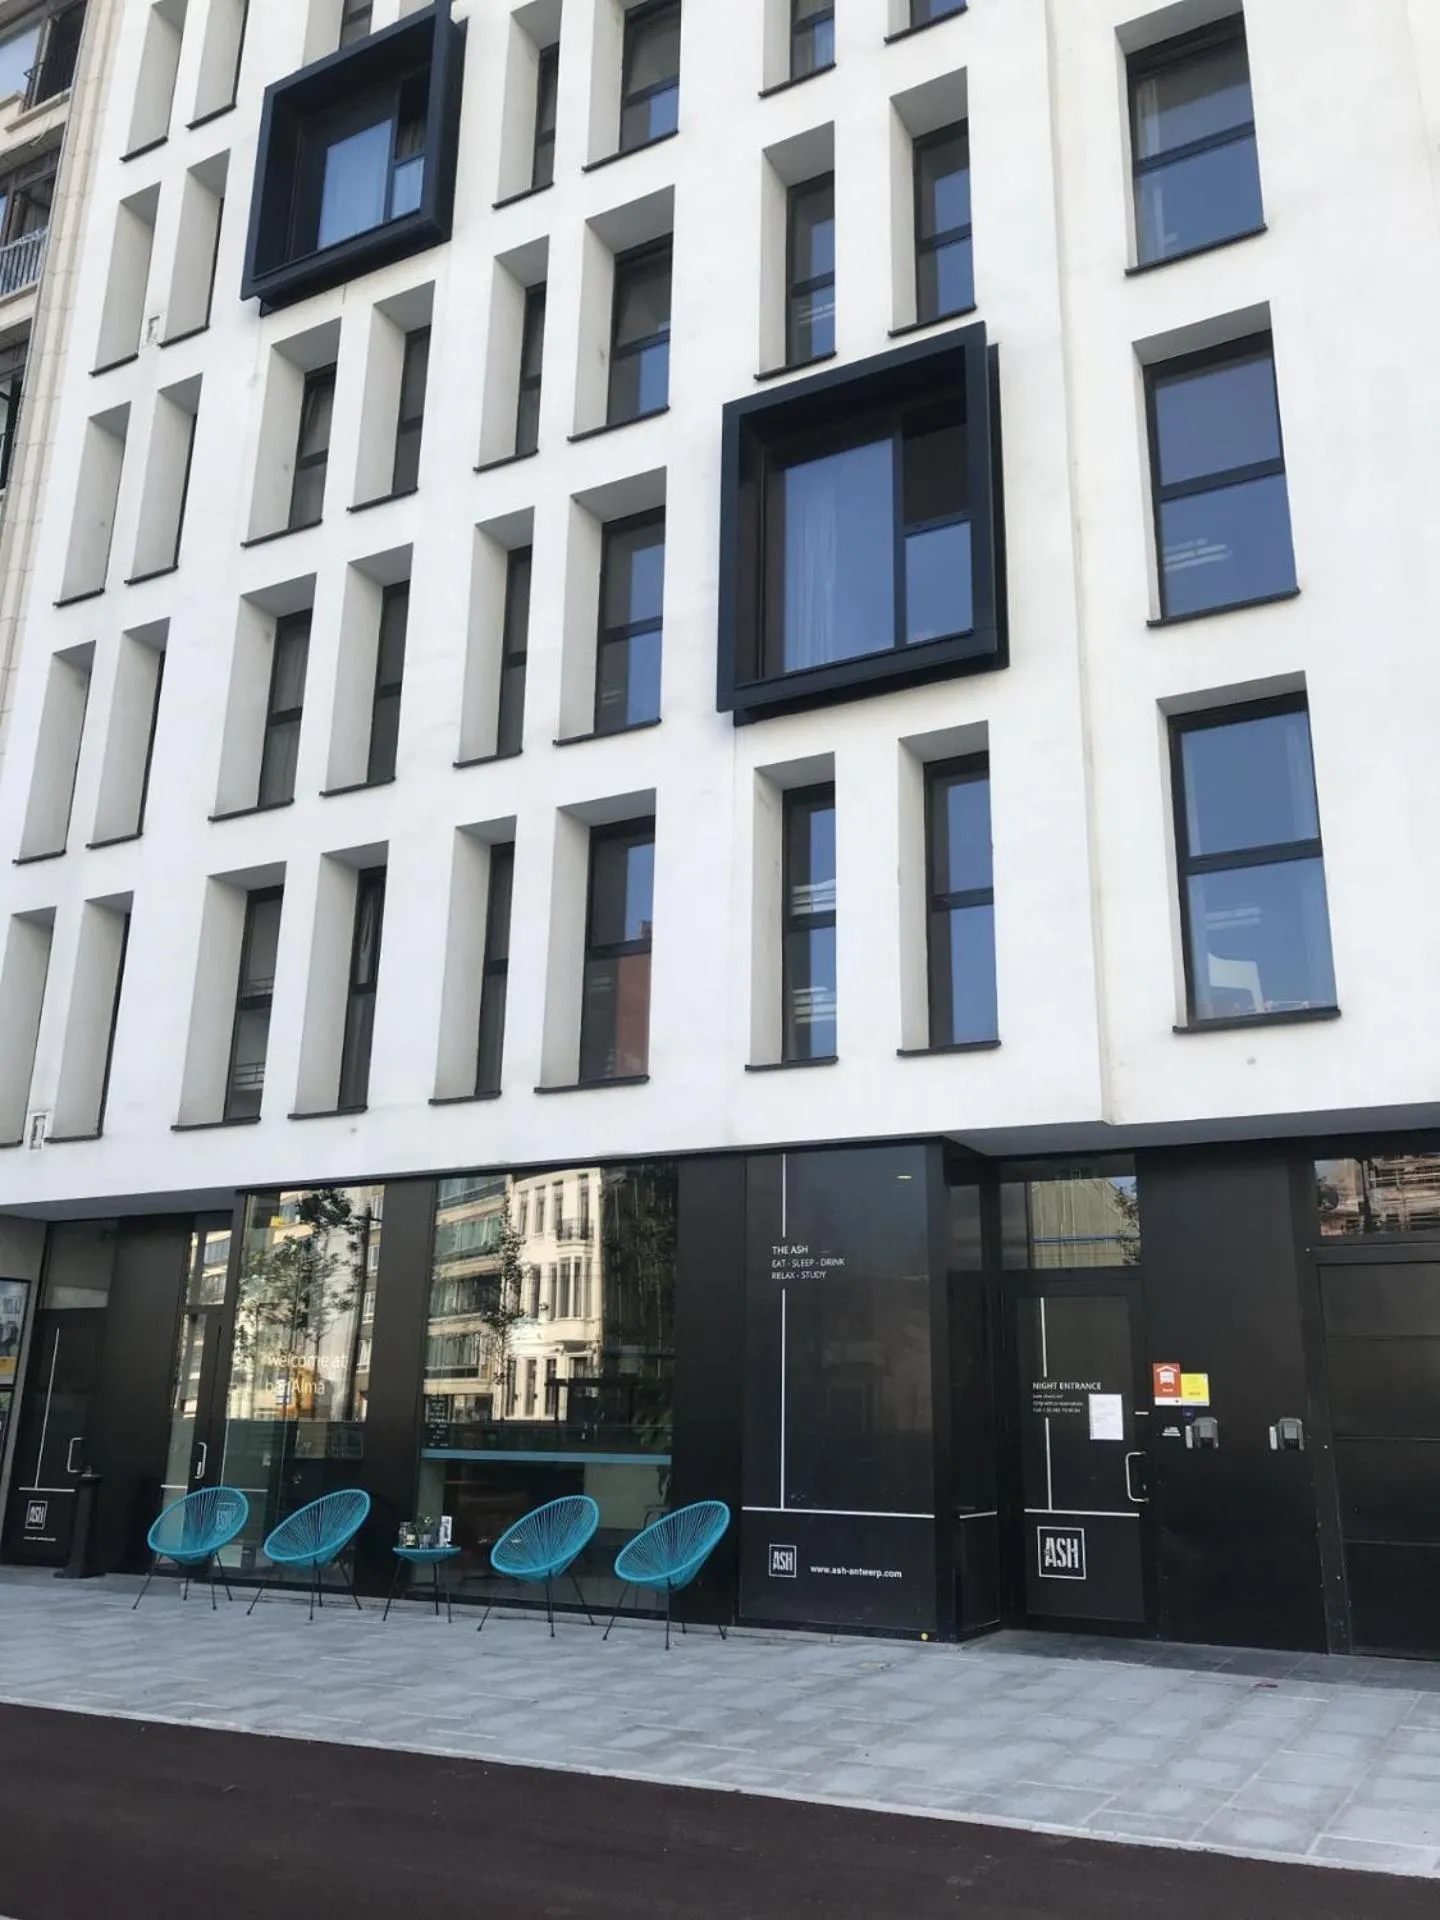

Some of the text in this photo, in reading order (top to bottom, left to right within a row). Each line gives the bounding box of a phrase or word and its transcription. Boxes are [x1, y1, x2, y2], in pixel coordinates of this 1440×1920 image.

[772, 1245, 809, 1255] THE ASH
[771, 1257, 846, 1268] EAT SLEEP DRINK
[771, 1270, 827, 1280] RELAX STUDY
[1032, 1381, 1102, 1391] NIGHT ENTRANCE
[1044, 1536, 1079, 1569] ASH
[772, 1550, 793, 1572] ASH
[809, 1565, 902, 1579] www.ash-antwerp.com
